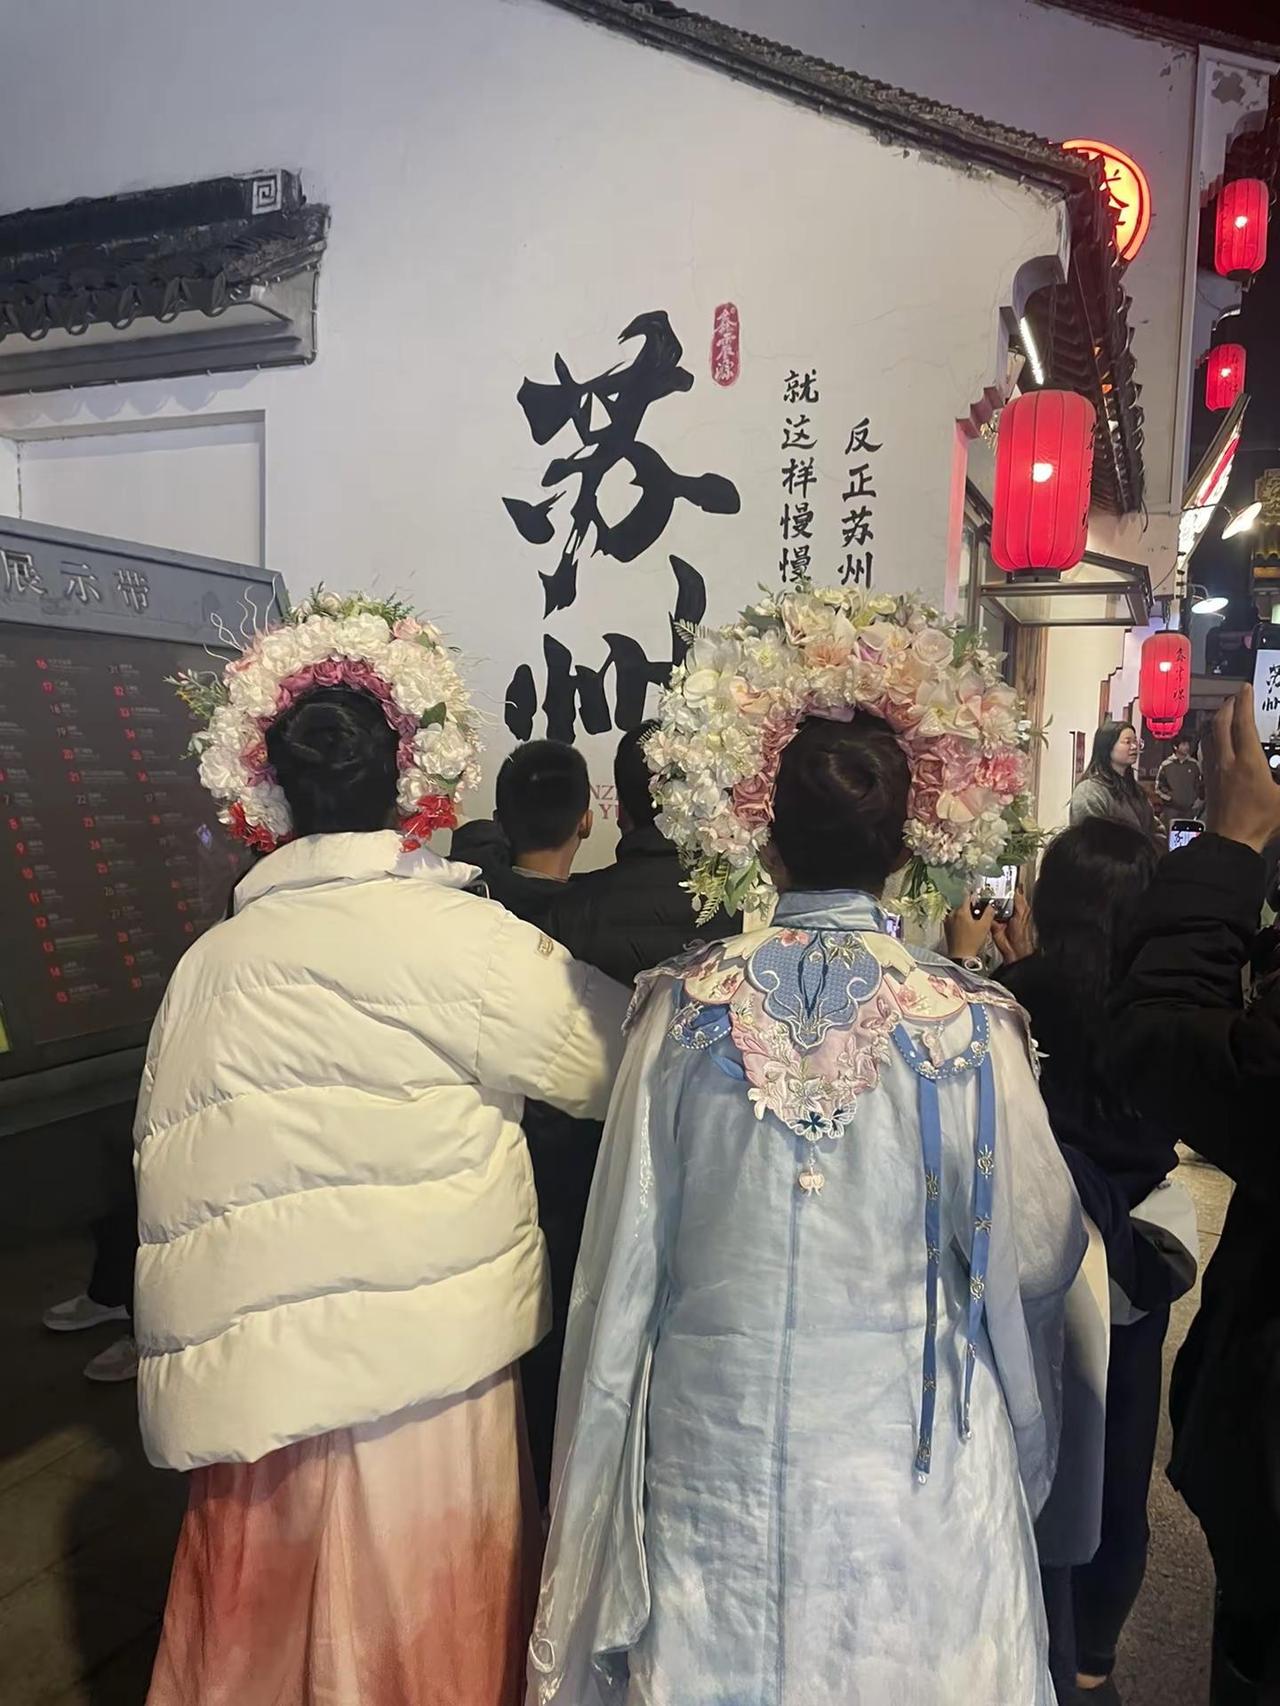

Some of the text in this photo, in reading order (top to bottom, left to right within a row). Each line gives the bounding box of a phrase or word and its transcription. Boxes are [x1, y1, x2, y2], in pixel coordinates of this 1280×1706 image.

[502, 310, 741, 746] 苏州
[779, 369, 819, 588] 就这样慢慢
[837, 417, 883, 589] 反正苏州
